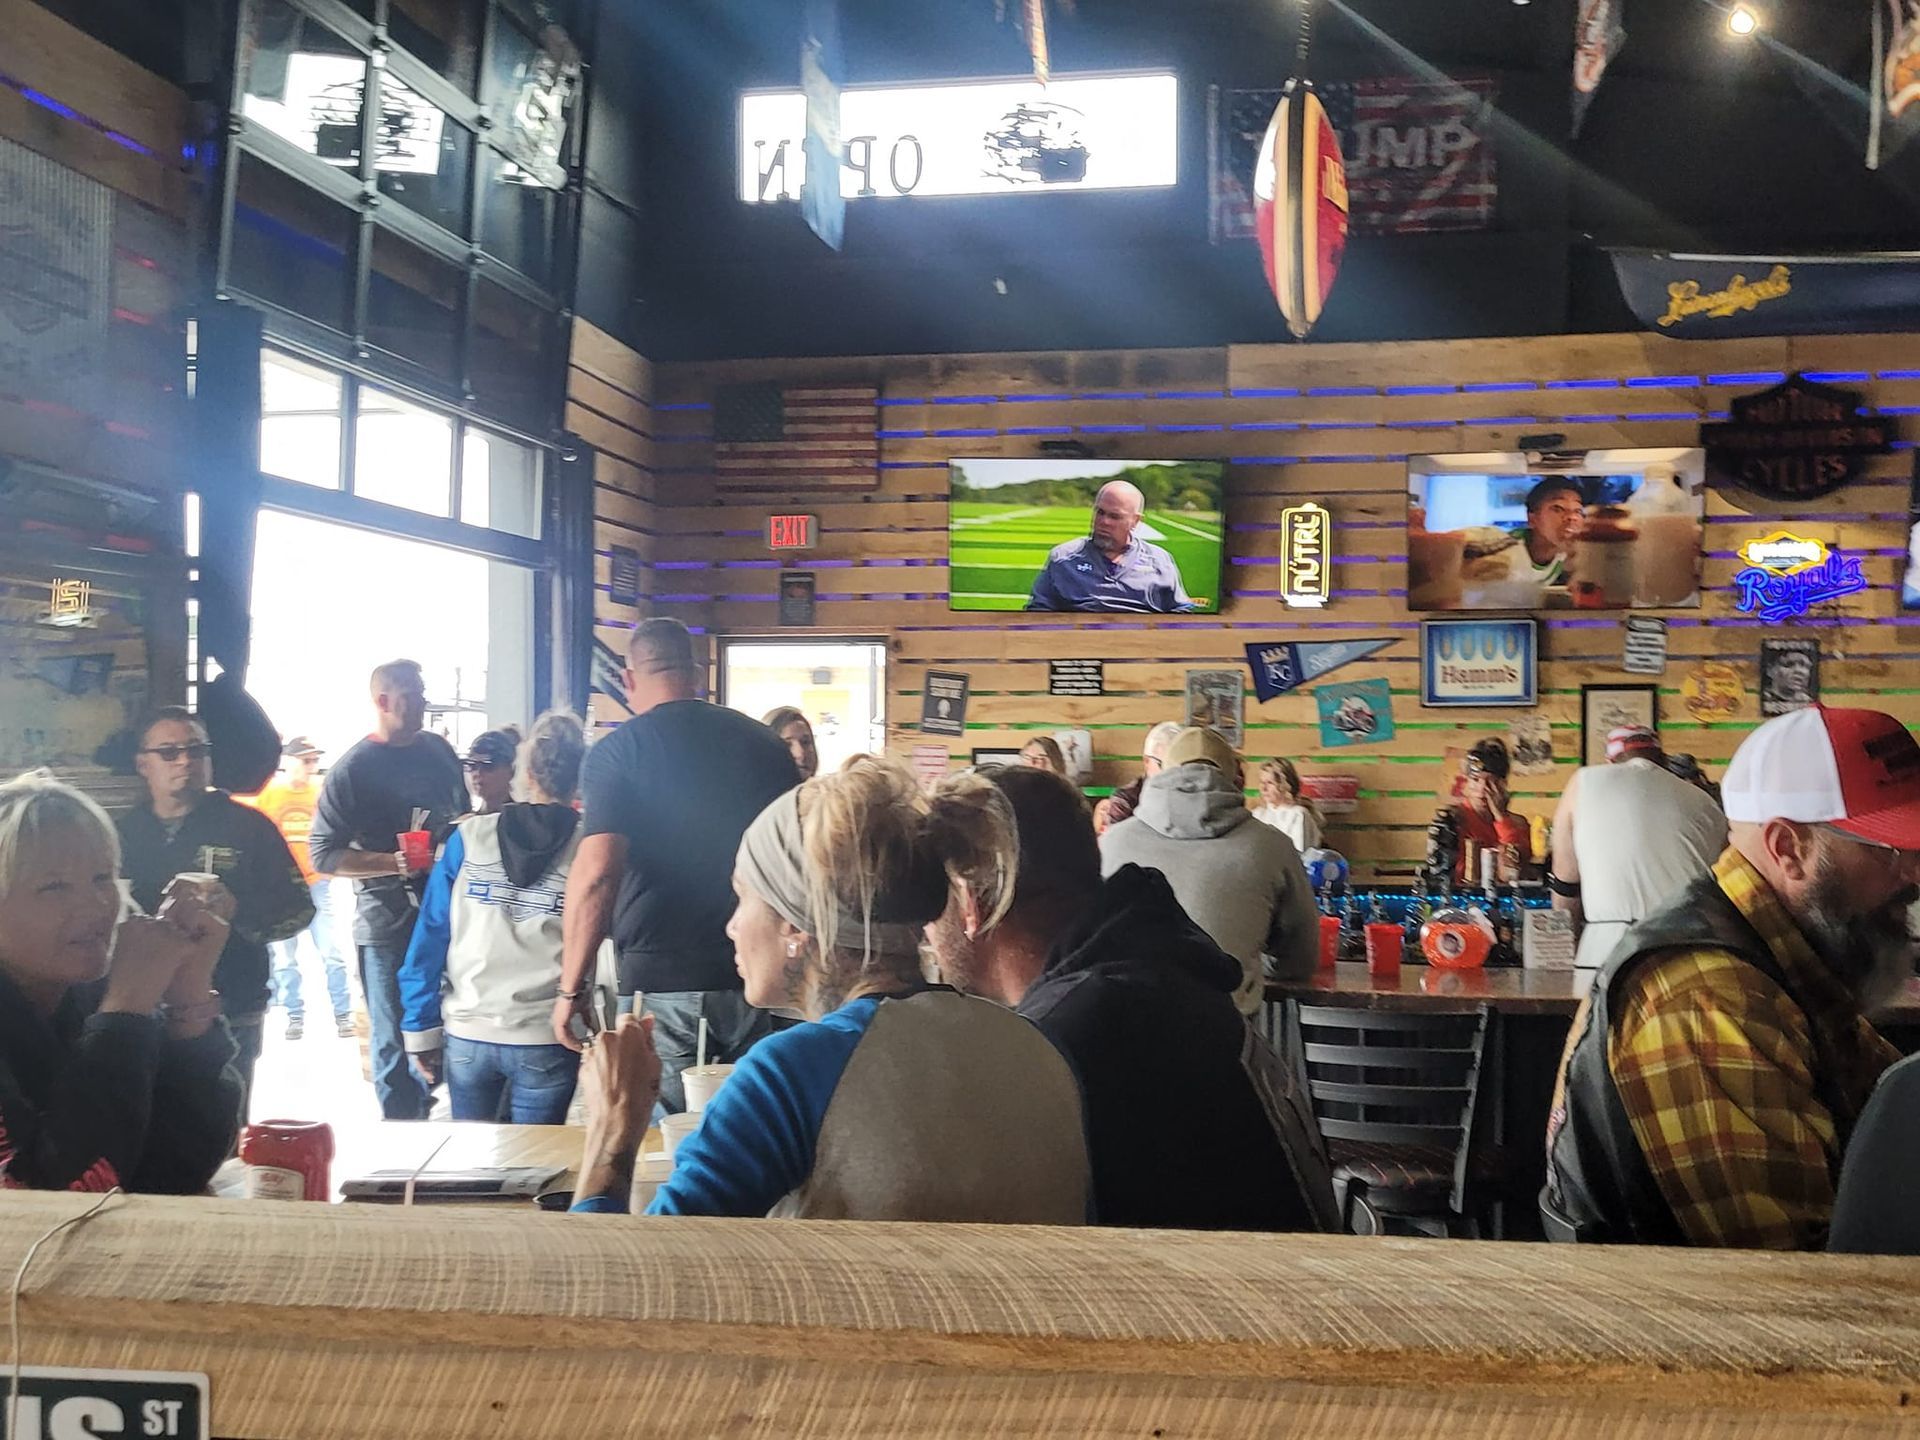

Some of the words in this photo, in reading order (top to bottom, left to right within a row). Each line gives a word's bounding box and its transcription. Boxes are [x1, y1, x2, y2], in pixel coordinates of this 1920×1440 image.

[770, 515, 809, 547] EXIT
[1735, 550, 1867, 623] Royals
[1440, 664, 1519, 684] Hamm's
[142, 1399, 183, 1436] ST
